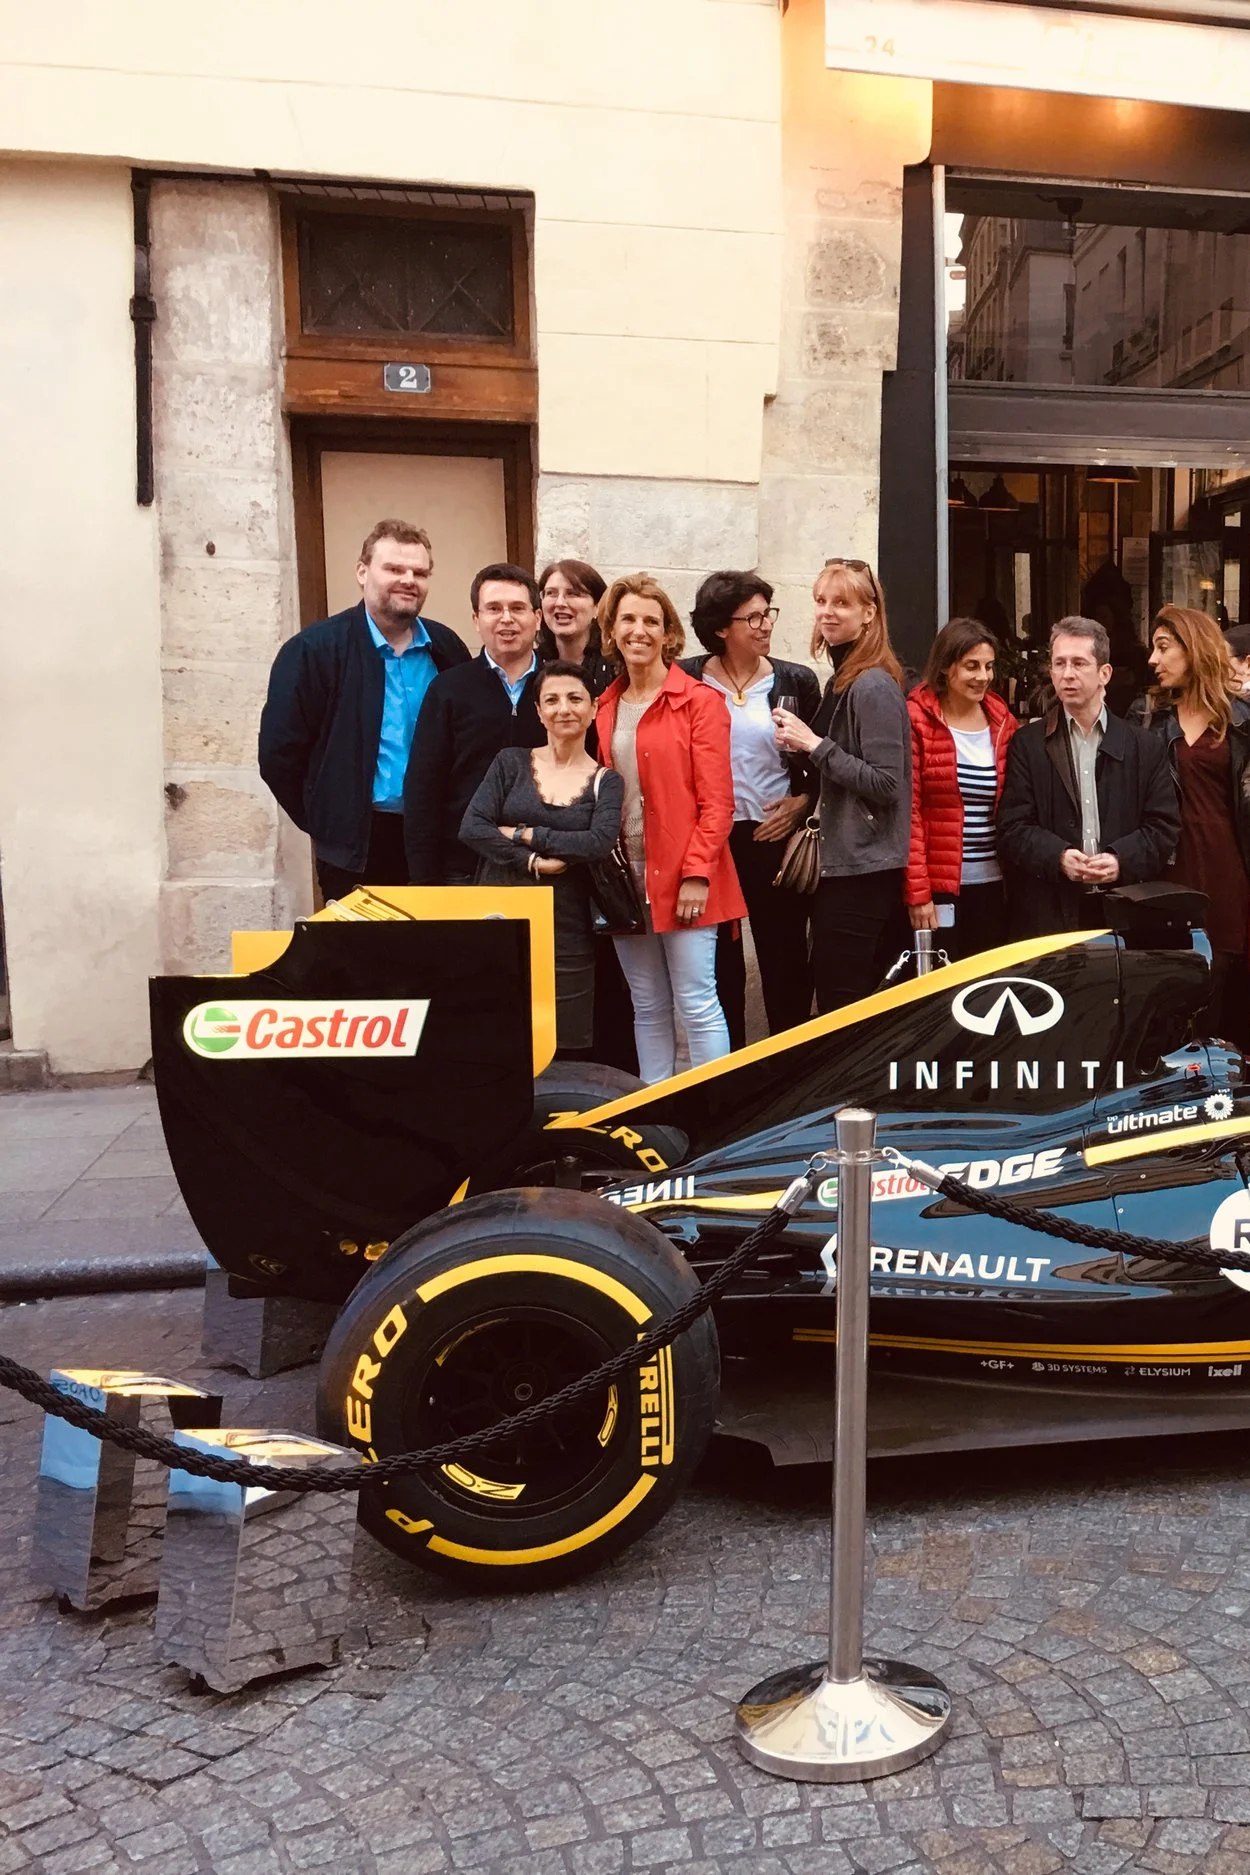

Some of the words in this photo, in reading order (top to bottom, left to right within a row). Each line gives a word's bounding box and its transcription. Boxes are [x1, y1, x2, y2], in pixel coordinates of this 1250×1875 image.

[399, 366, 417, 388] 2
[246, 1007, 410, 1050] Castrol
[889, 1060, 1125, 1090] INFINITI
[1108, 1105, 1198, 1134] ultimate
[870, 1246, 1051, 1282] RENAULT
[1047, 1363, 1060, 1372] 3D
[1062, 1364, 1108, 1374] SYSTEMS
[1139, 1367, 1191, 1377] ELYSIUM
